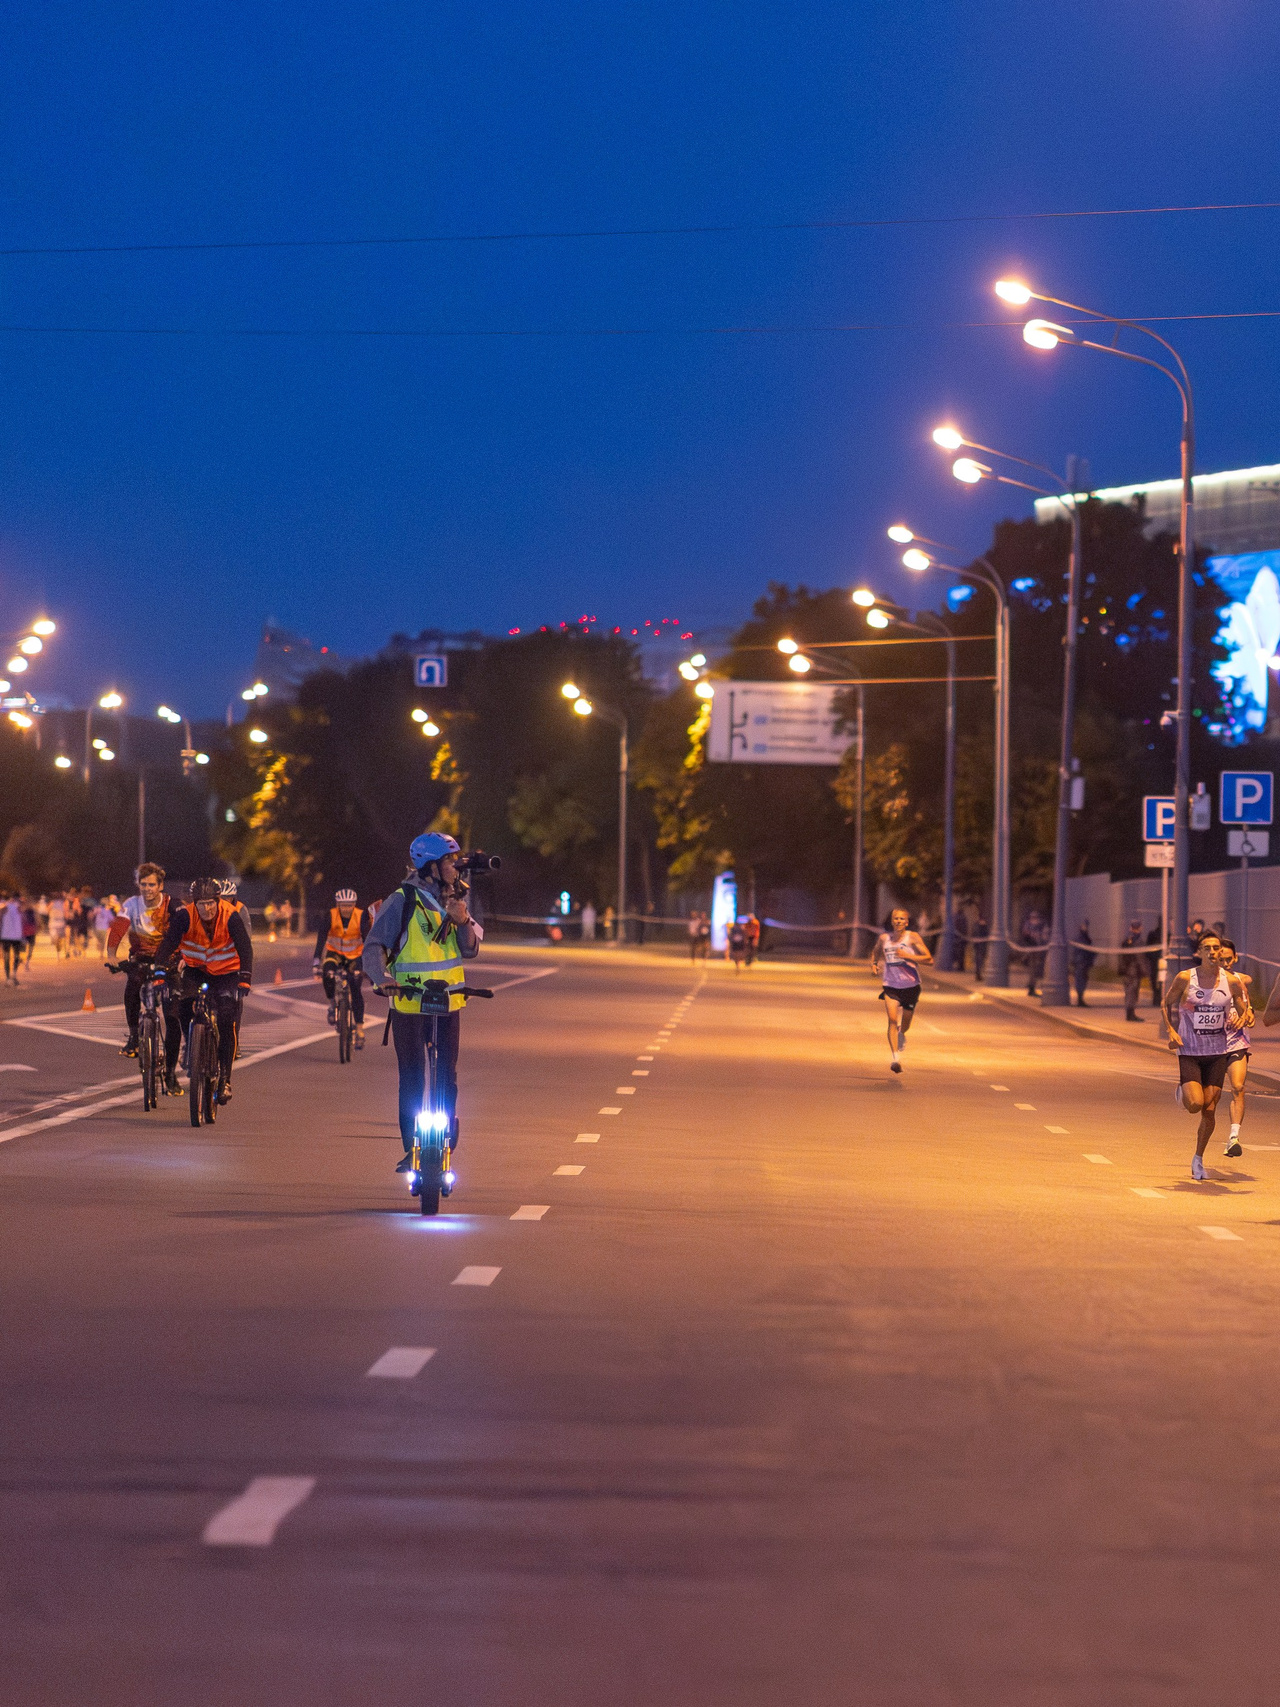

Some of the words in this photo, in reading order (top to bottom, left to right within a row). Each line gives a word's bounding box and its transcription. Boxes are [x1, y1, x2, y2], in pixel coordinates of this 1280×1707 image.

[1235, 778, 1264, 818] P
[1156, 802, 1175, 837] P
[1198, 1014, 1221, 1024] 2867
